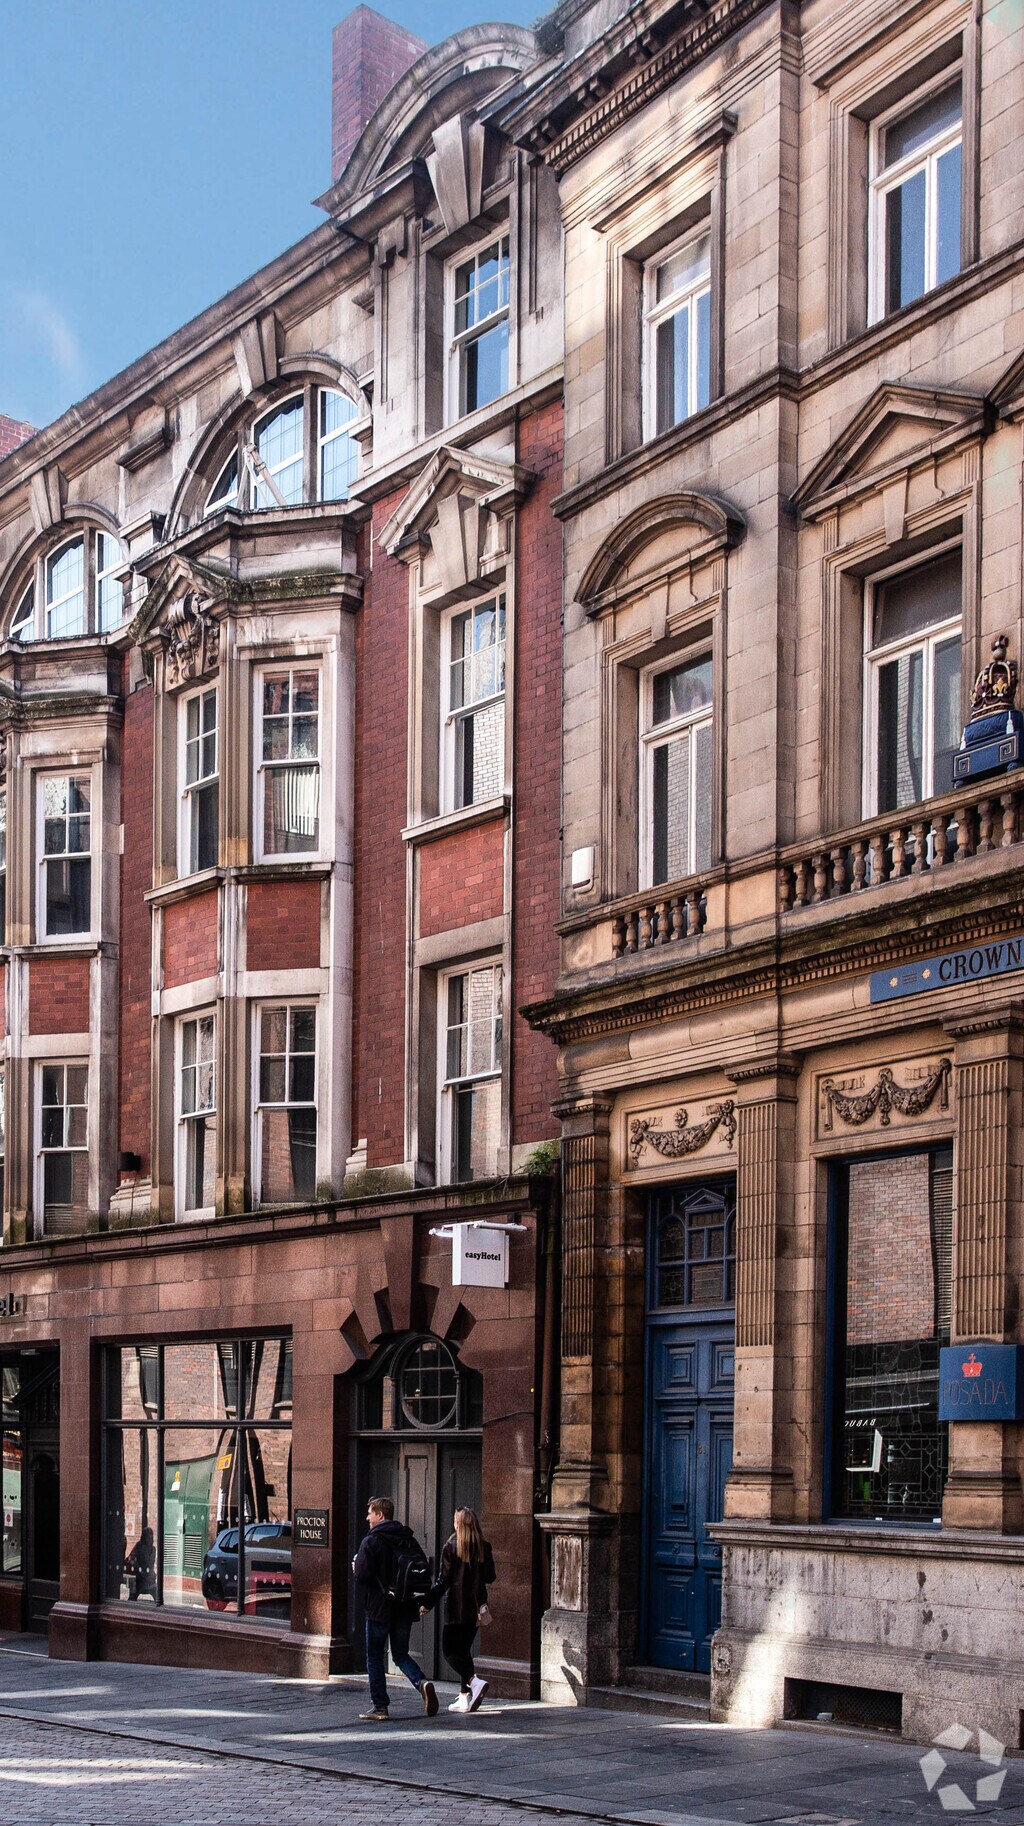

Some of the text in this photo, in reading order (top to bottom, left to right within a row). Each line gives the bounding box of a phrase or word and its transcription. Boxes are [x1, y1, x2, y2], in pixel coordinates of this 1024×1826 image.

[939, 939, 1022, 982] CROWN
[465, 1251, 501, 1262] easyHotel
[942, 1378, 1009, 1407] POSADA
[297, 1516, 326, 1527] PROCTOR
[300, 1529, 323, 1540] HOUSE
